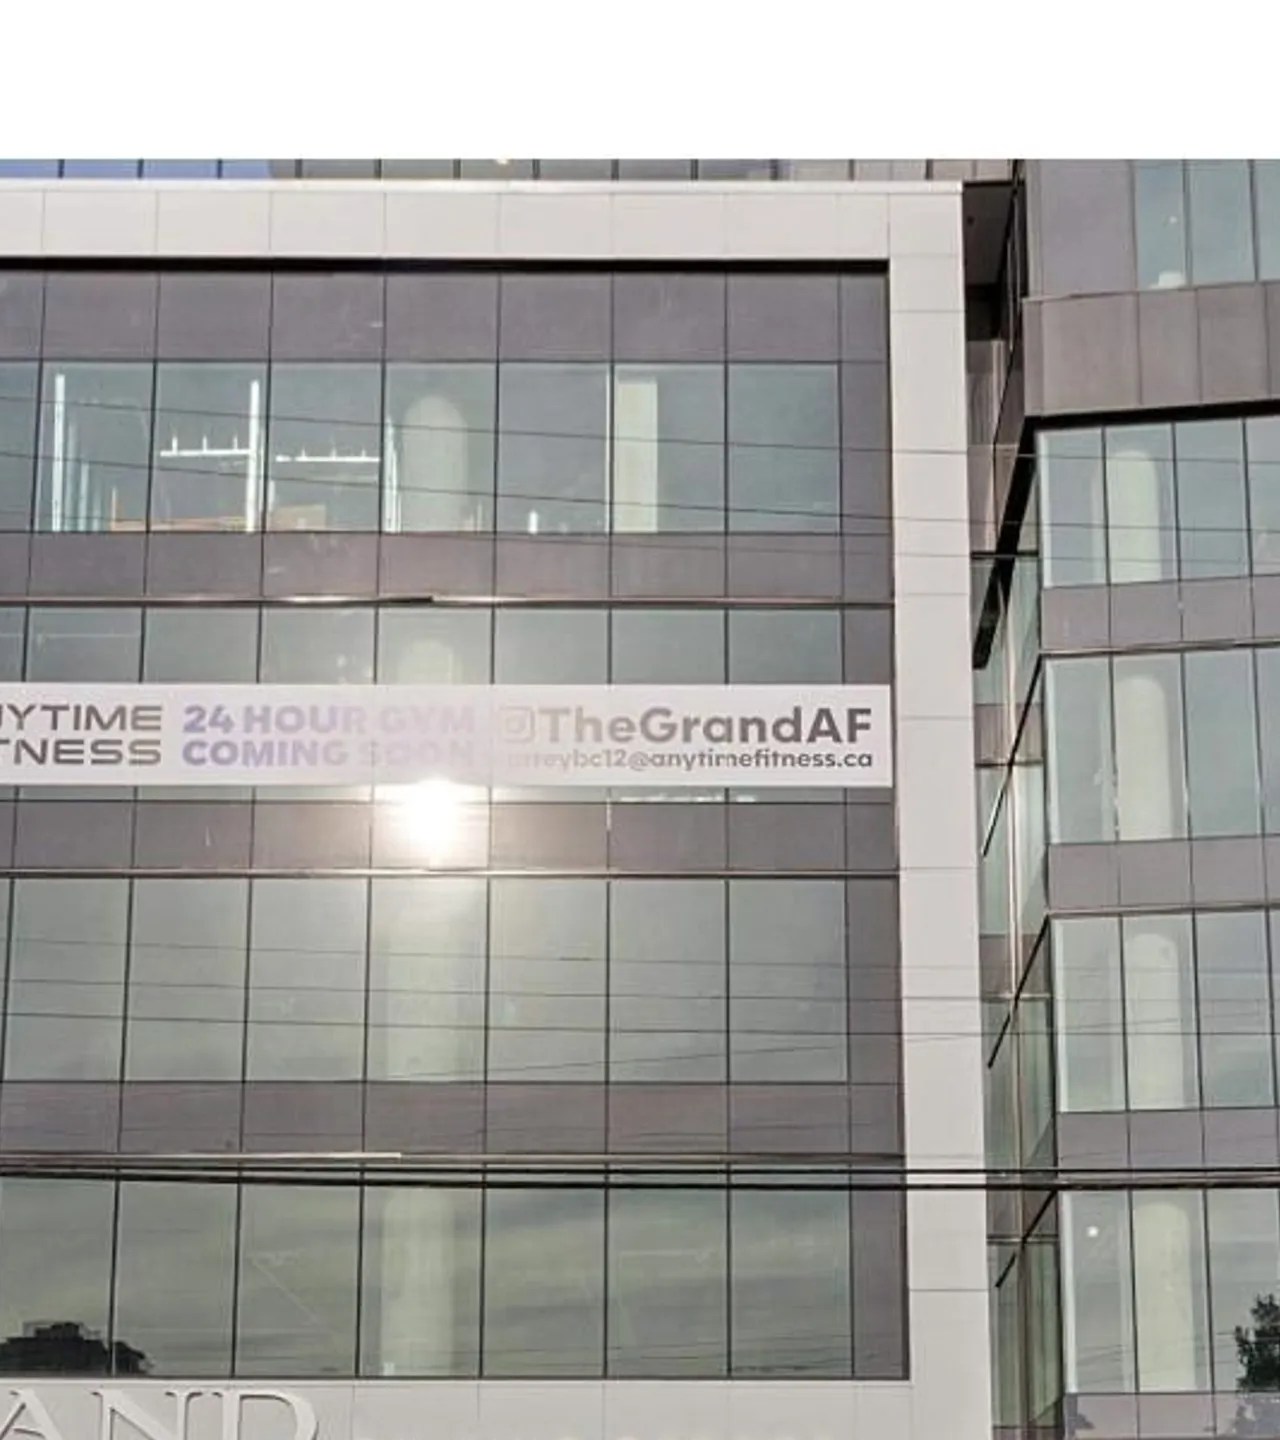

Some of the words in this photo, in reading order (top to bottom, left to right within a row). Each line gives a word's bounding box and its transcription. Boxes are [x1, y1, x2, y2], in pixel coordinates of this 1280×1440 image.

[182, 704, 235, 734] 24
[242, 704, 369, 735] HOUR
[181, 739, 350, 768] COMING
